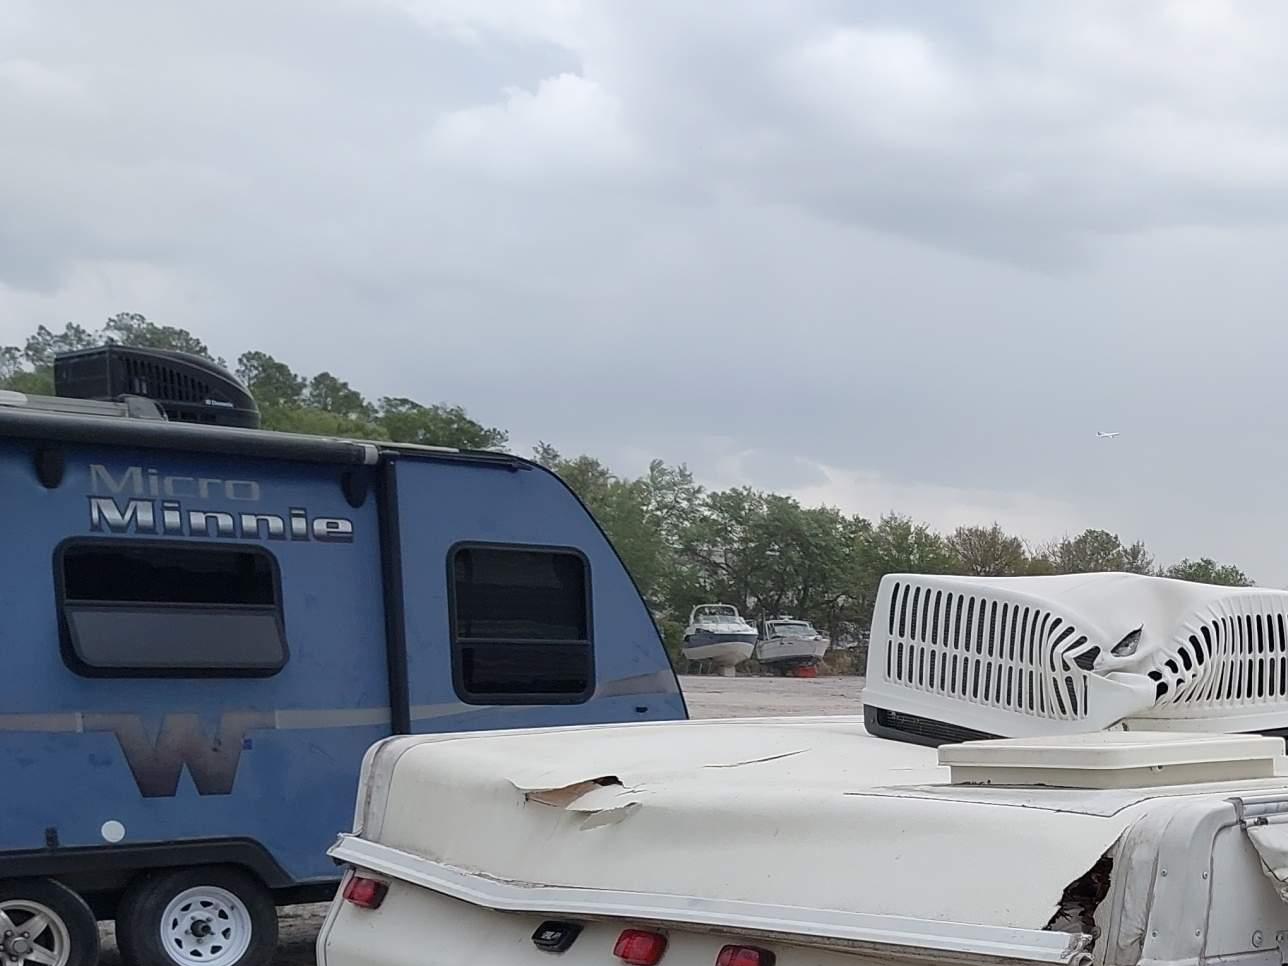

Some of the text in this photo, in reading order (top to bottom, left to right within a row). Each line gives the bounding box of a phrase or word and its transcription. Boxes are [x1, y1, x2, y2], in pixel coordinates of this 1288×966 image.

[89, 464, 260, 500] Micro
[87, 496, 354, 543] Minnie
[98, 711, 262, 798] W
